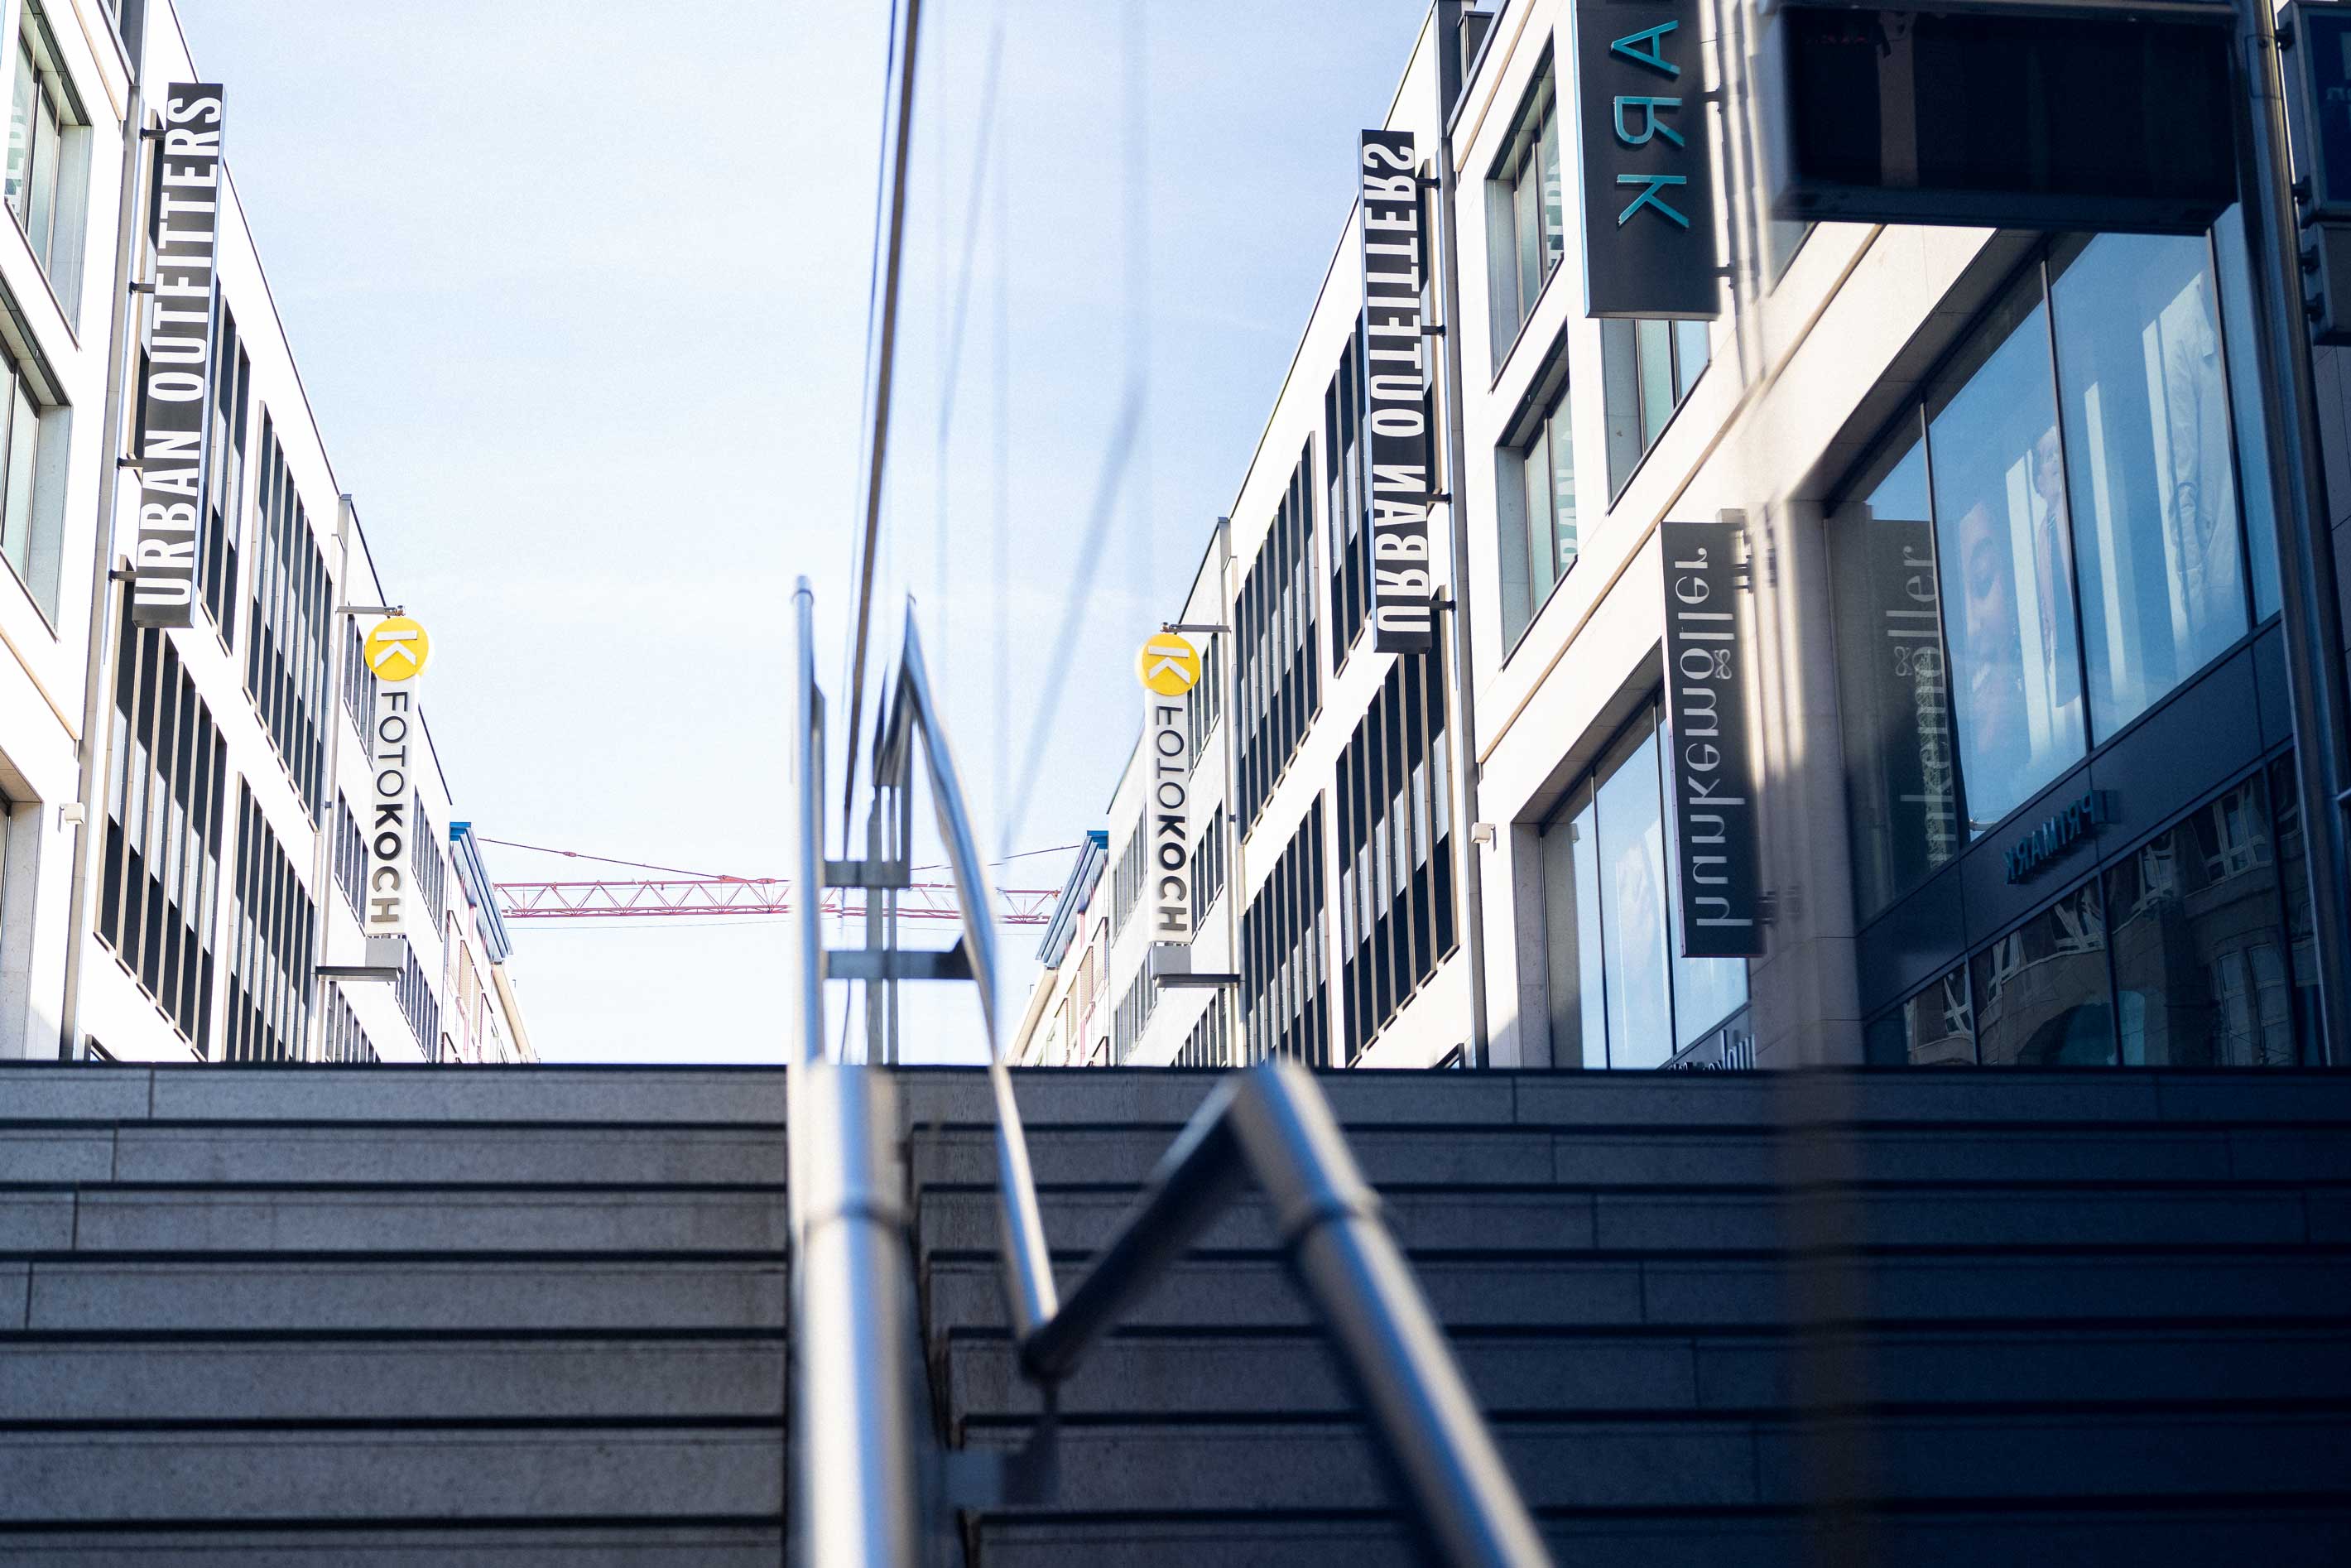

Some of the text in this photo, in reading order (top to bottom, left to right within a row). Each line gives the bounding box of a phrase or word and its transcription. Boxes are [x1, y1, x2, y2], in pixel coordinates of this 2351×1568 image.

[133, 97, 223, 606] URBAN OUTFITTERS
[373, 630, 418, 669] K
